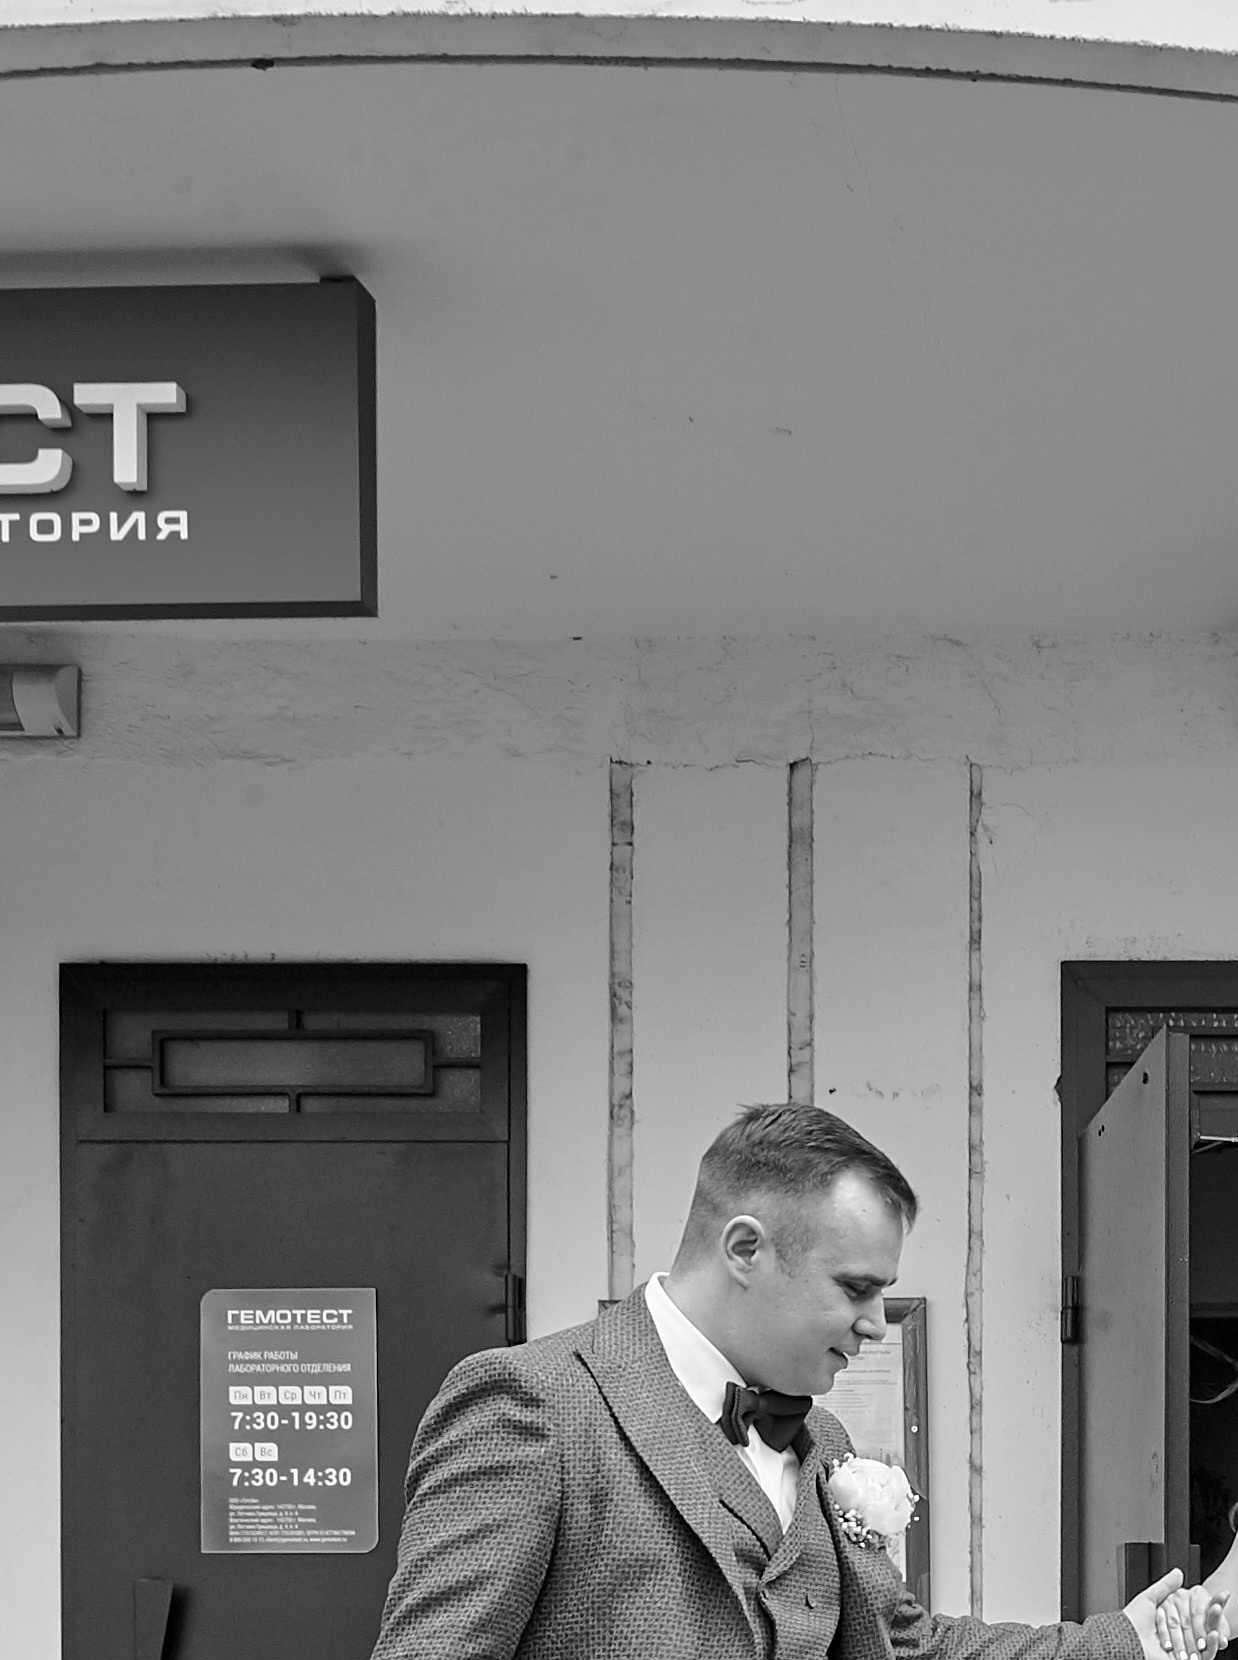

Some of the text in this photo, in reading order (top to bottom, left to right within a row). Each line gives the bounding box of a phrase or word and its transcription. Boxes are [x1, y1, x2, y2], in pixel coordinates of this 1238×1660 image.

[0, 510, 189, 542] ТОРИЯ
[227, 1309, 353, 1324] ГЕМОТЕСТ
[228, 1350, 299, 1361] ГРАФИК РАБОТЫ
[228, 1362, 352, 1374] ЛАБОРАТОРНОГО ОТДЕЛЕНИЯ
[234, 1389, 347, 1402] Пн Вт Ср Чт Пт
[230, 1411, 353, 1430] 7:30-19:30
[235, 1447, 273, 1457] Сб Вс
[229, 1467, 352, 1487] 7:30-14:30
